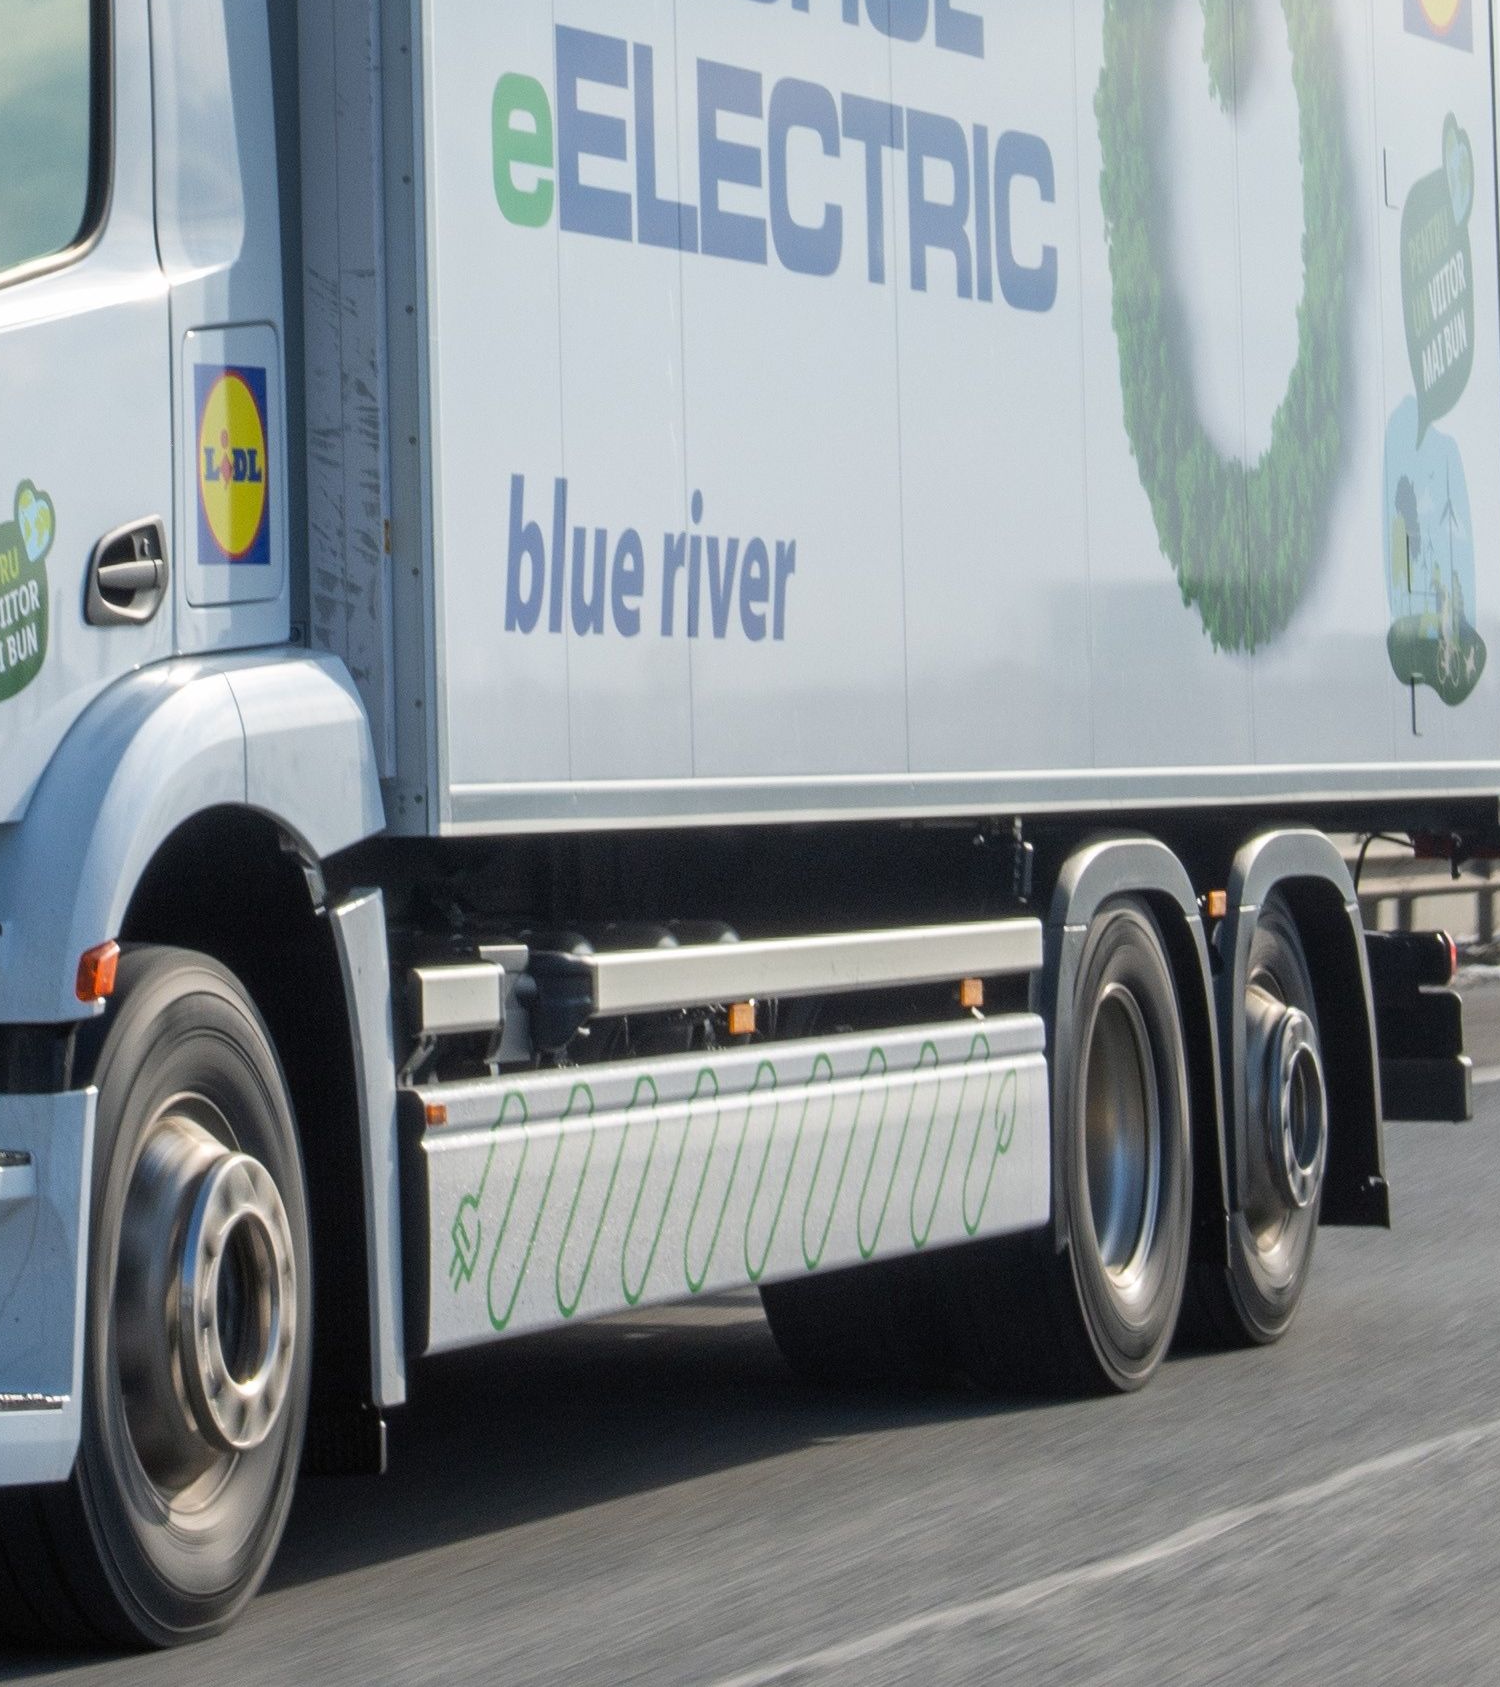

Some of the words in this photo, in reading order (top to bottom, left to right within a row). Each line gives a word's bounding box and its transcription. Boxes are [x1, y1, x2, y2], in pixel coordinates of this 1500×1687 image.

[491, 23, 1058, 313] eELECTRIC
[1408, 206, 1449, 281] PENTRU
[1412, 286, 1431, 339] UN
[1428, 251, 1466, 319] VIITOR
[1423, 333, 1445, 391] MAI
[1444, 311, 1467, 367] BUN
[504, 473, 645, 638] blue
[660, 488, 797, 642] river
[8, 628, 38, 661] BUN
